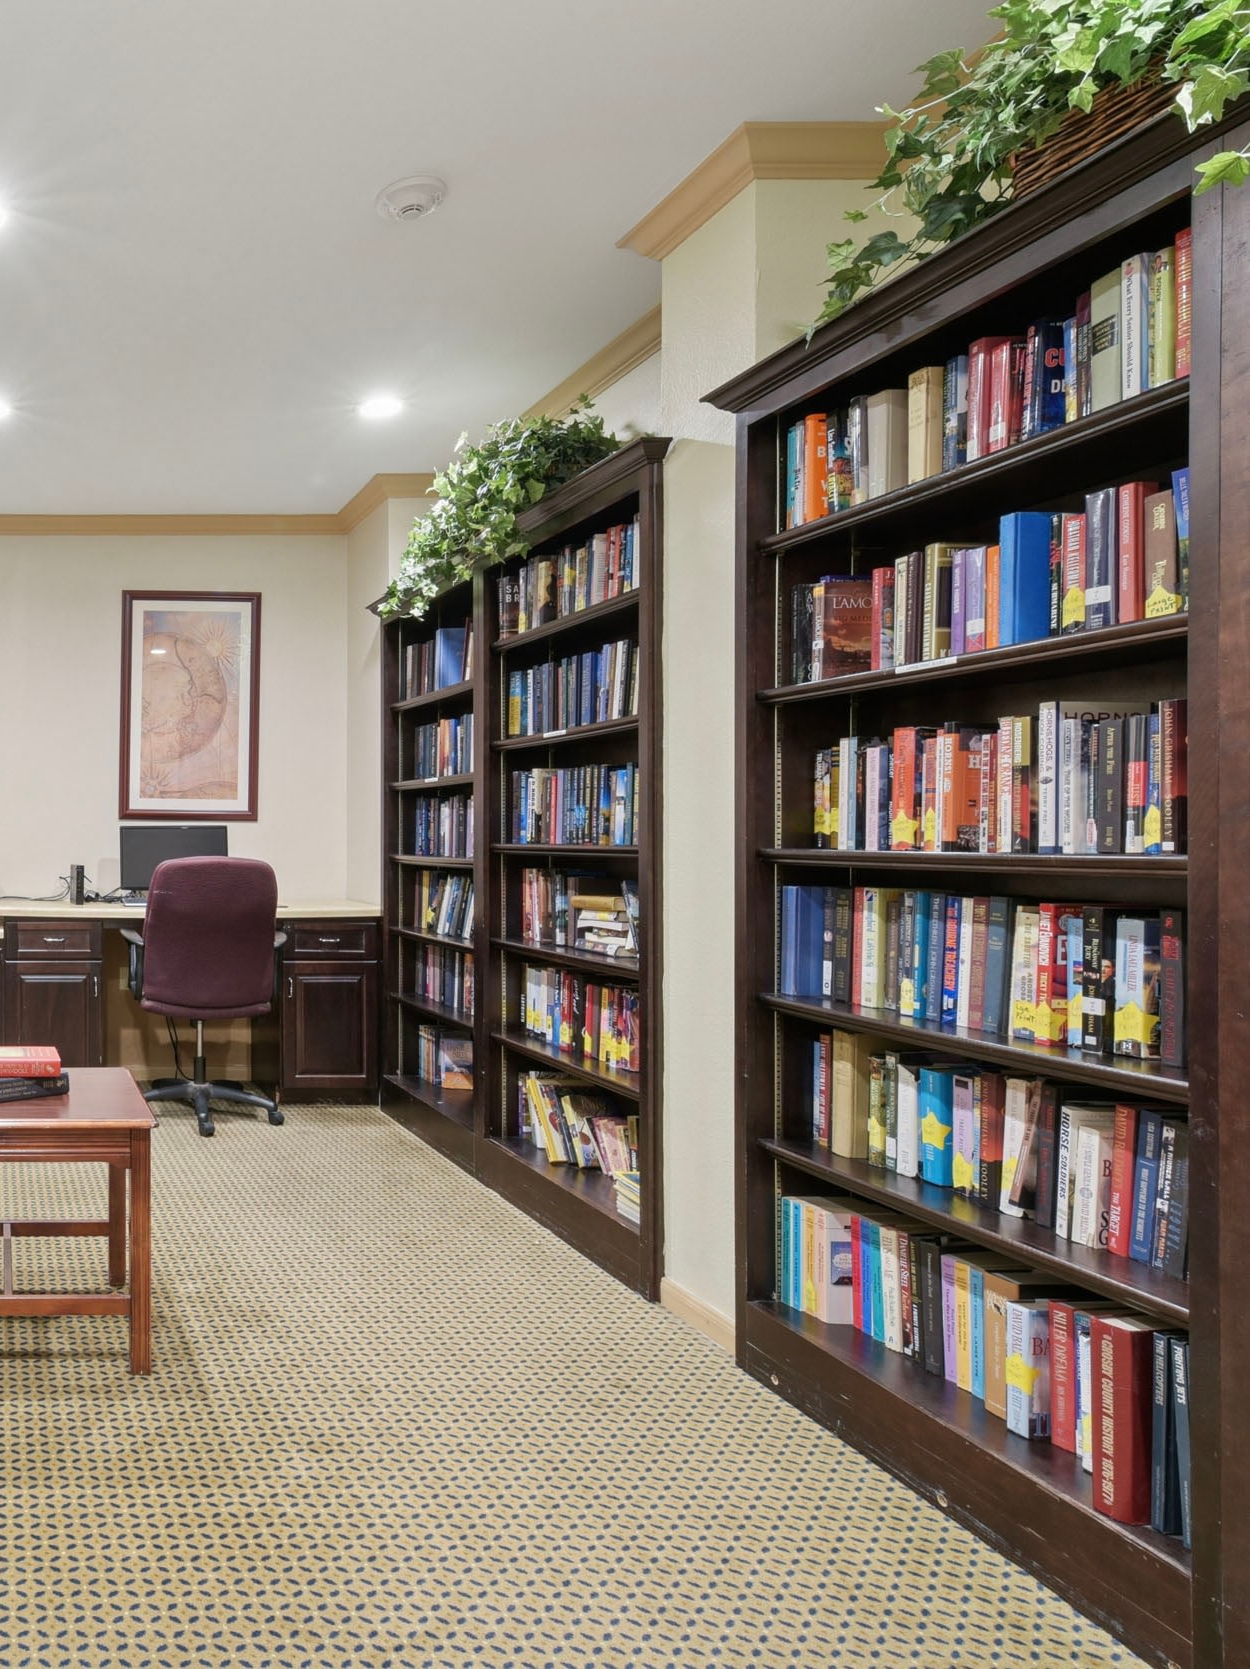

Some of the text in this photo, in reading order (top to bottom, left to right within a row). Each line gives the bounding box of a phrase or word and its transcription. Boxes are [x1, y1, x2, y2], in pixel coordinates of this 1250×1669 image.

[1125, 275, 1134, 296] What
[1125, 297, 1134, 316] Every
[1126, 318, 1134, 342] Senior
[1126, 342, 1134, 367] Should
[1050, 582, 1058, 630] SUBMARINE
[1000, 720, 1012, 760] BLEEDING
[1014, 722, 1022, 764] ROSENBERG
[1164, 708, 1172, 837] JOHN GRISHAM SOOLEY
[932, 897, 940, 911] THE
[945, 918, 957, 991] BOURNE TREACHERY
[1038, 911, 1052, 966] JANET EVANOVICH
[1084, 944, 1092, 960] JURY
[1091, 938, 1099, 968] RUNAWAY
[929, 968, 937, 1002] GRISHAM
[1116, 1108, 1128, 1140] DAVID
[1059, 1111, 1070, 1200] HORSE SOLDIERS
[980, 1162, 988, 1200] SOOLEY
[1112, 1192, 1120, 1204] THE
[1139, 1182, 1148, 1203] HAPPENED
[1162, 1181, 1171, 1200] CALL
[1110, 1204, 1122, 1236] TARGET
[900, 1238, 910, 1288] DANIELLE STEEL
[1012, 1308, 1022, 1331] DAVID
[1053, 1310, 1068, 1384] KILLER DREAMS
[1154, 1339, 1164, 1406] THE HELICOPTERS
[1174, 1346, 1186, 1405] FIGHTING JETS
[1101, 1340, 1114, 1500] CROSBY COUNTY HISTORY 1876-1977
